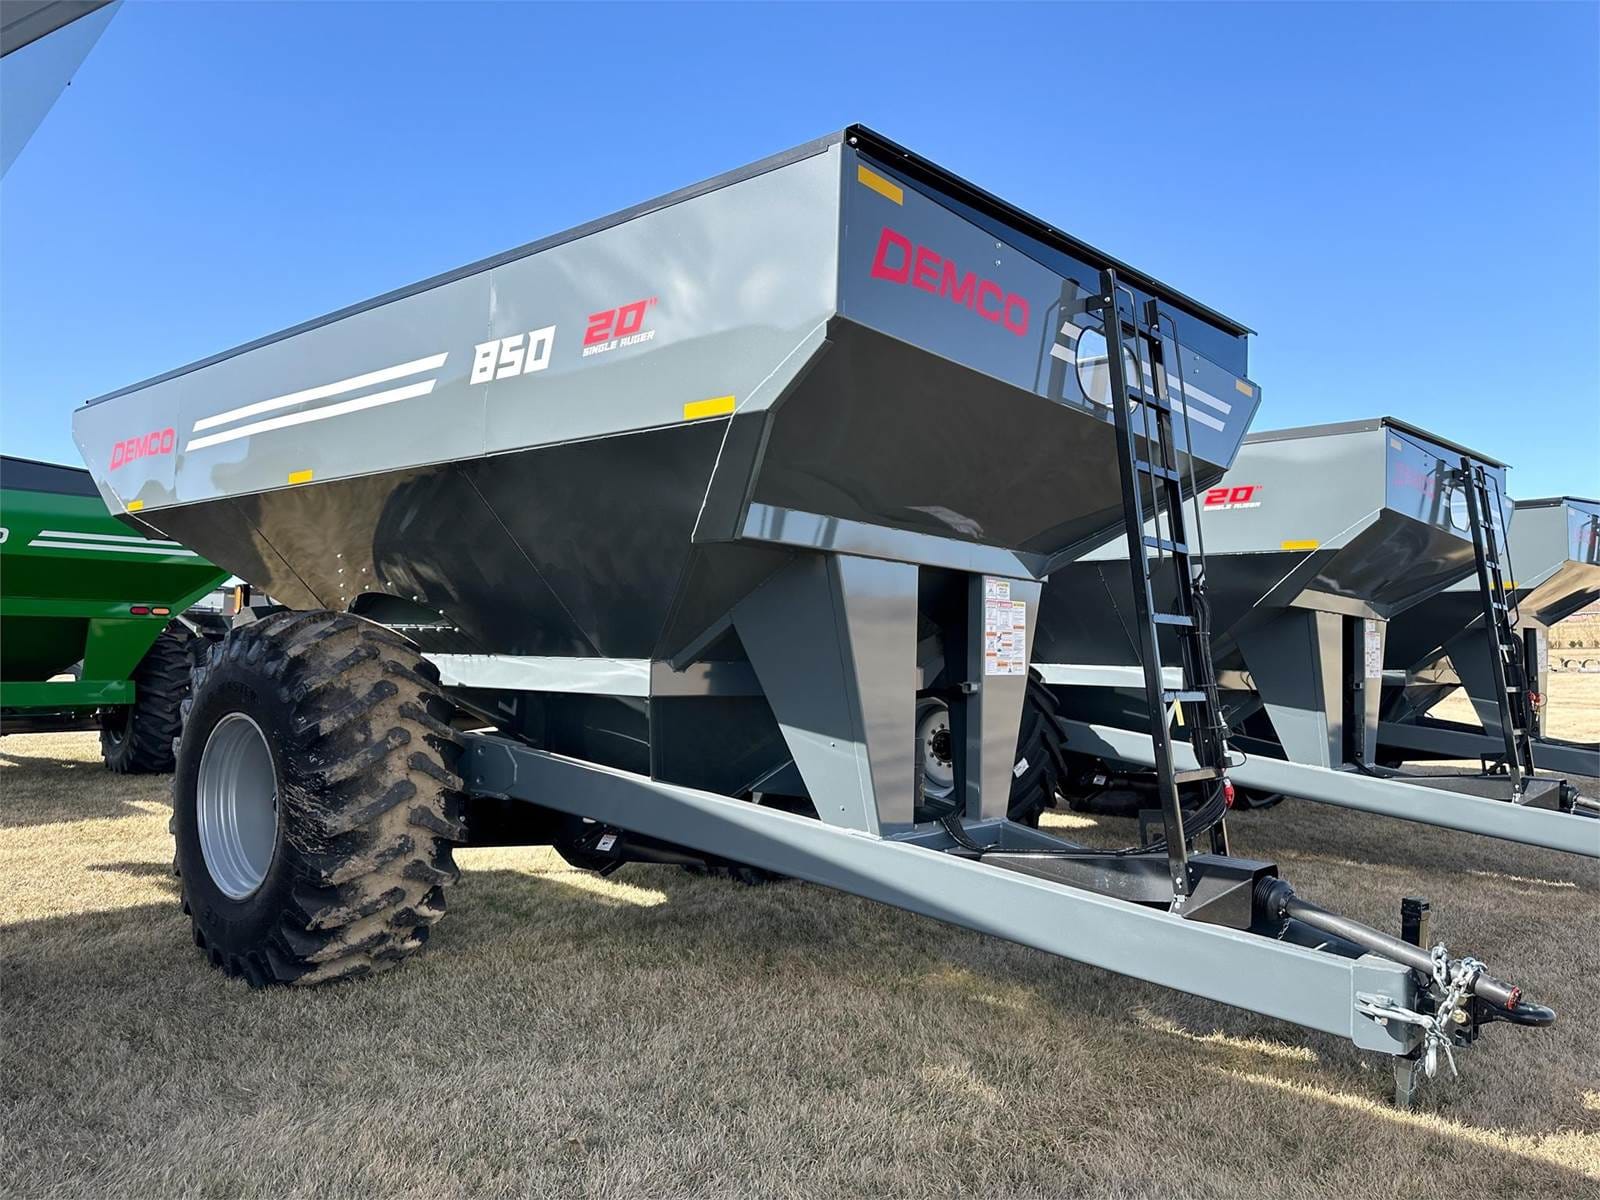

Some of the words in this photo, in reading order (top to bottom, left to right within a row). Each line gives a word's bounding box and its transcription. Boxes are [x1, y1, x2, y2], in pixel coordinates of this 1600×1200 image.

[870, 226, 1030, 336] DEMCO
[582, 339, 618, 358] SINGLE
[620, 330, 656, 349] AUGER
[583, 297, 657, 346] 20"
[470, 325, 556, 385] 850
[110, 427, 175, 471] DEMCO
